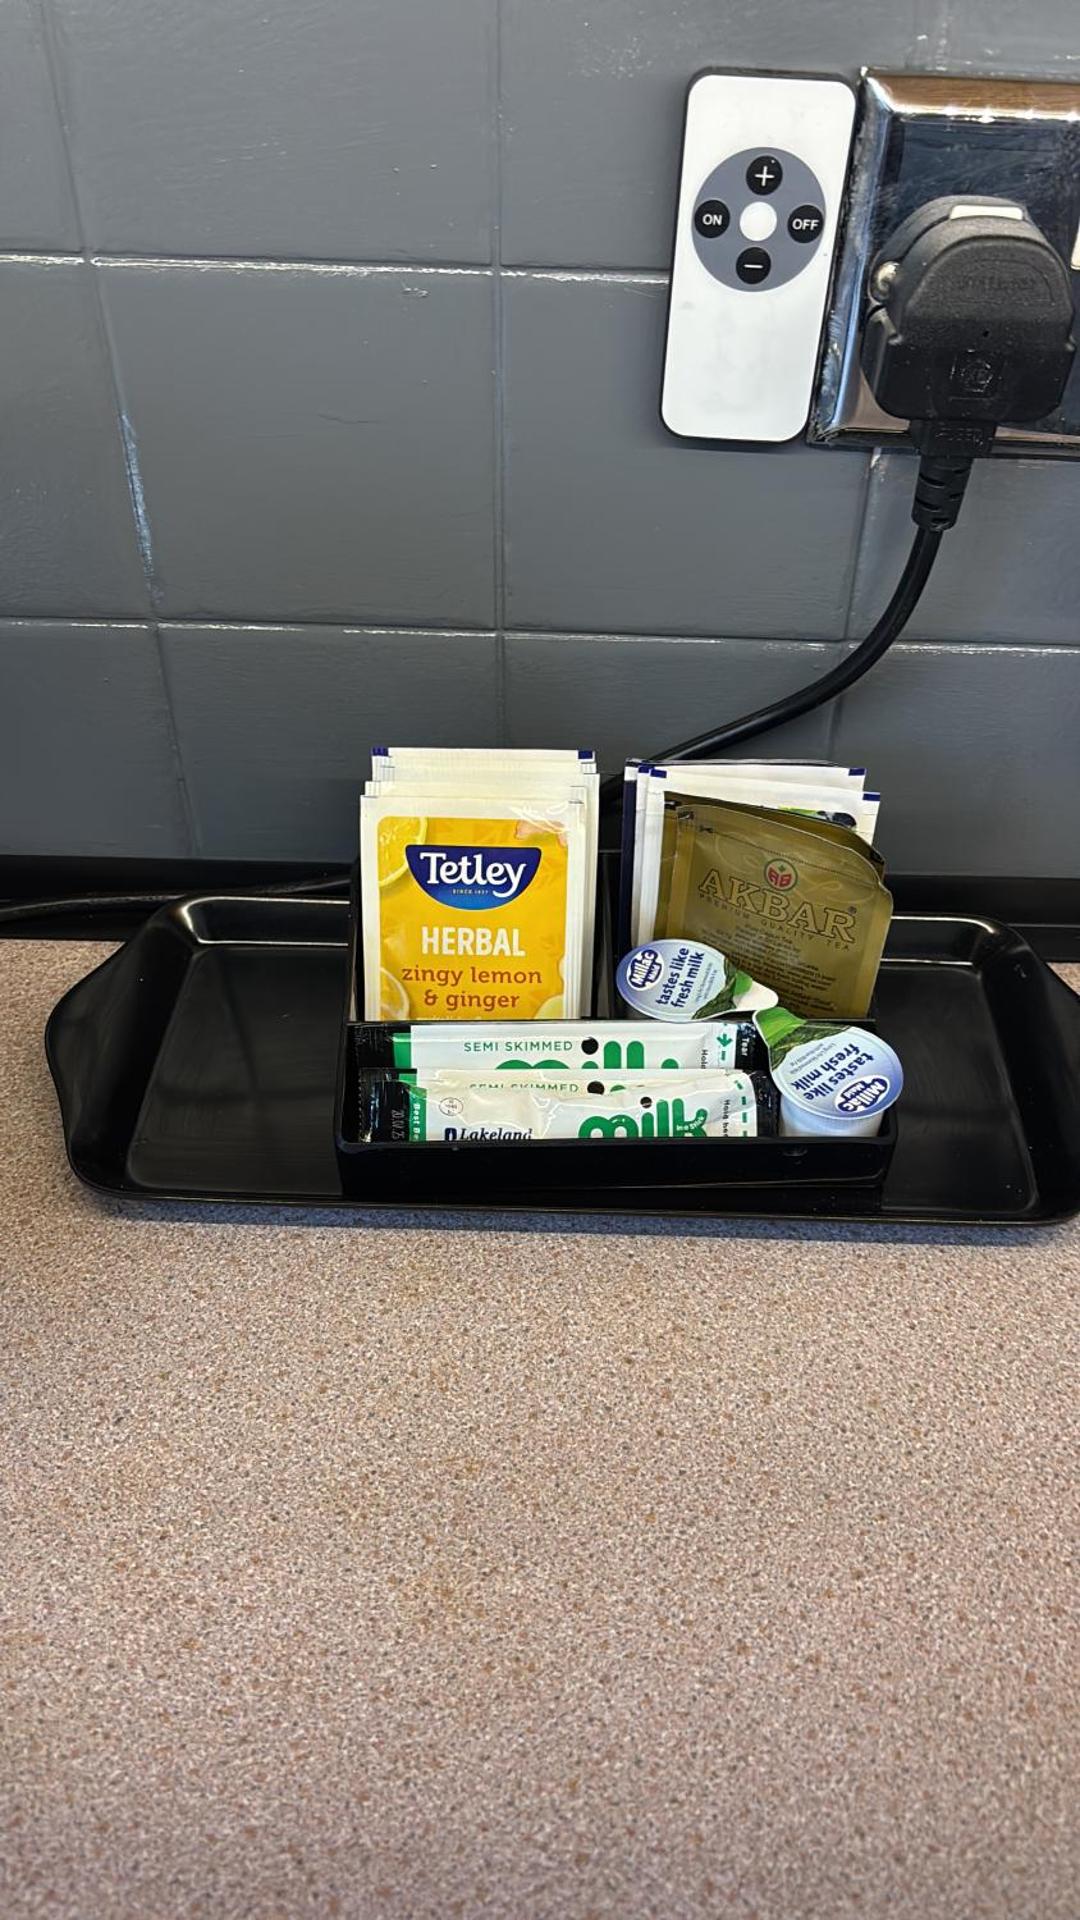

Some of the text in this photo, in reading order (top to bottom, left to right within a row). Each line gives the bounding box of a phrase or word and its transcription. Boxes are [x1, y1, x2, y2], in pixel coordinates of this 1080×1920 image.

[702, 214, 722, 226] ON
[792, 218, 819, 231] OFF
[419, 851, 527, 898] Tetley
[698, 868, 856, 943] AKBAR
[700, 893, 751, 919] PREMIUM
[760, 919, 815, 941] QUALITY
[826, 939, 850, 951] TEA
[421, 925, 526, 957] HERBAL
[401, 965, 542, 987] zingy lemon
[656, 947, 690, 1005] tastes like
[671, 951, 705, 1008] fresh milk
[424, 989, 520, 1012] & ginger
[464, 1040, 573, 1052] SEMI SKIMMED
[741, 1037, 750, 1056] Tear
[820, 1043, 861, 1072] fresh
[790, 1068, 823, 1091] milk
[828, 1052, 874, 1086] tastes
[803, 1082, 834, 1101] like
[841, 1081, 886, 1112] Millac
[578, 1096, 708, 1138] milk
[459, 1127, 534, 1140] Lakeland
